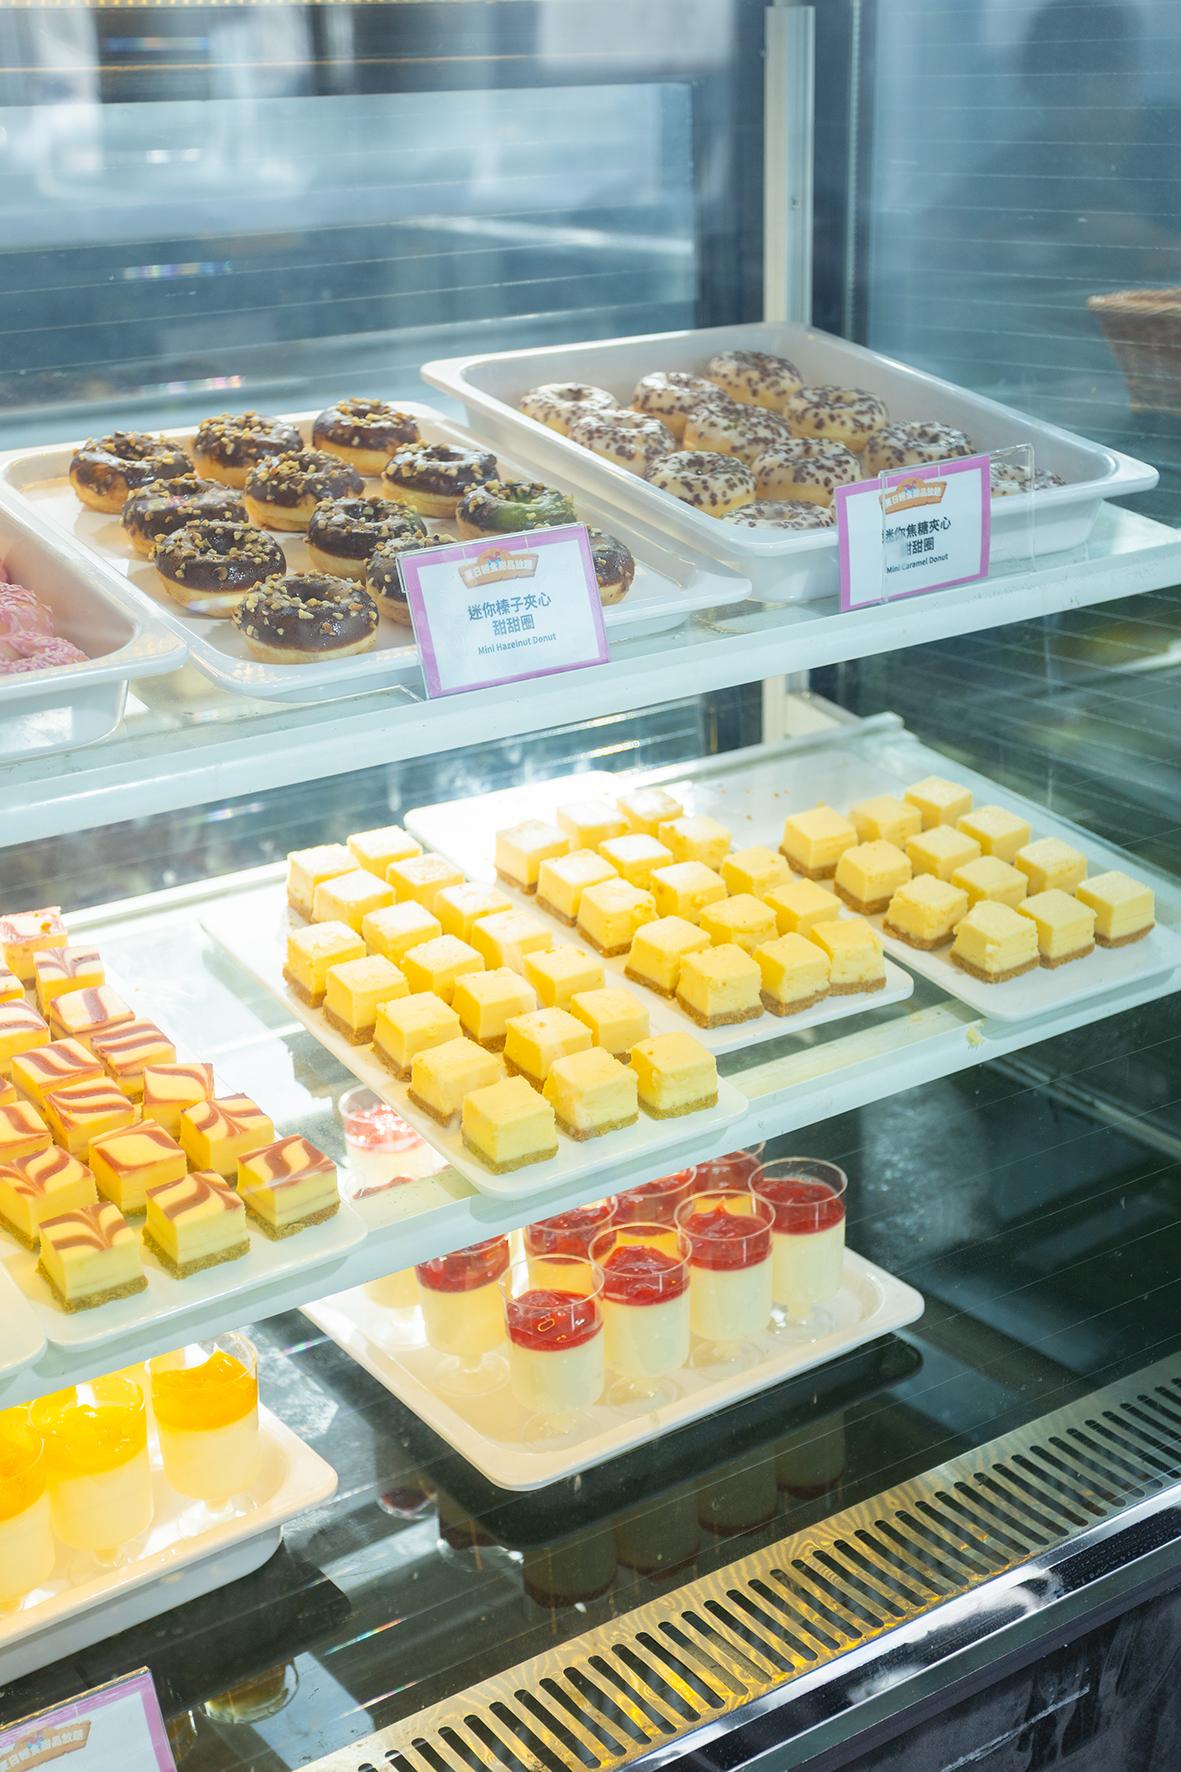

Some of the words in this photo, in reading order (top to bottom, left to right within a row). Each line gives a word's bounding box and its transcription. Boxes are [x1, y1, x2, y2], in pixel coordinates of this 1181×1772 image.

[886, 564, 900, 574] Mini
[929, 553, 949, 564] Donut
[468, 592, 552, 620] 迷你榛子夾心
[492, 614, 535, 636] 甜甜圈
[478, 645, 495, 655] Mini
[496, 638, 532, 652] Hazelnut
[532, 633, 557, 644] Donut
